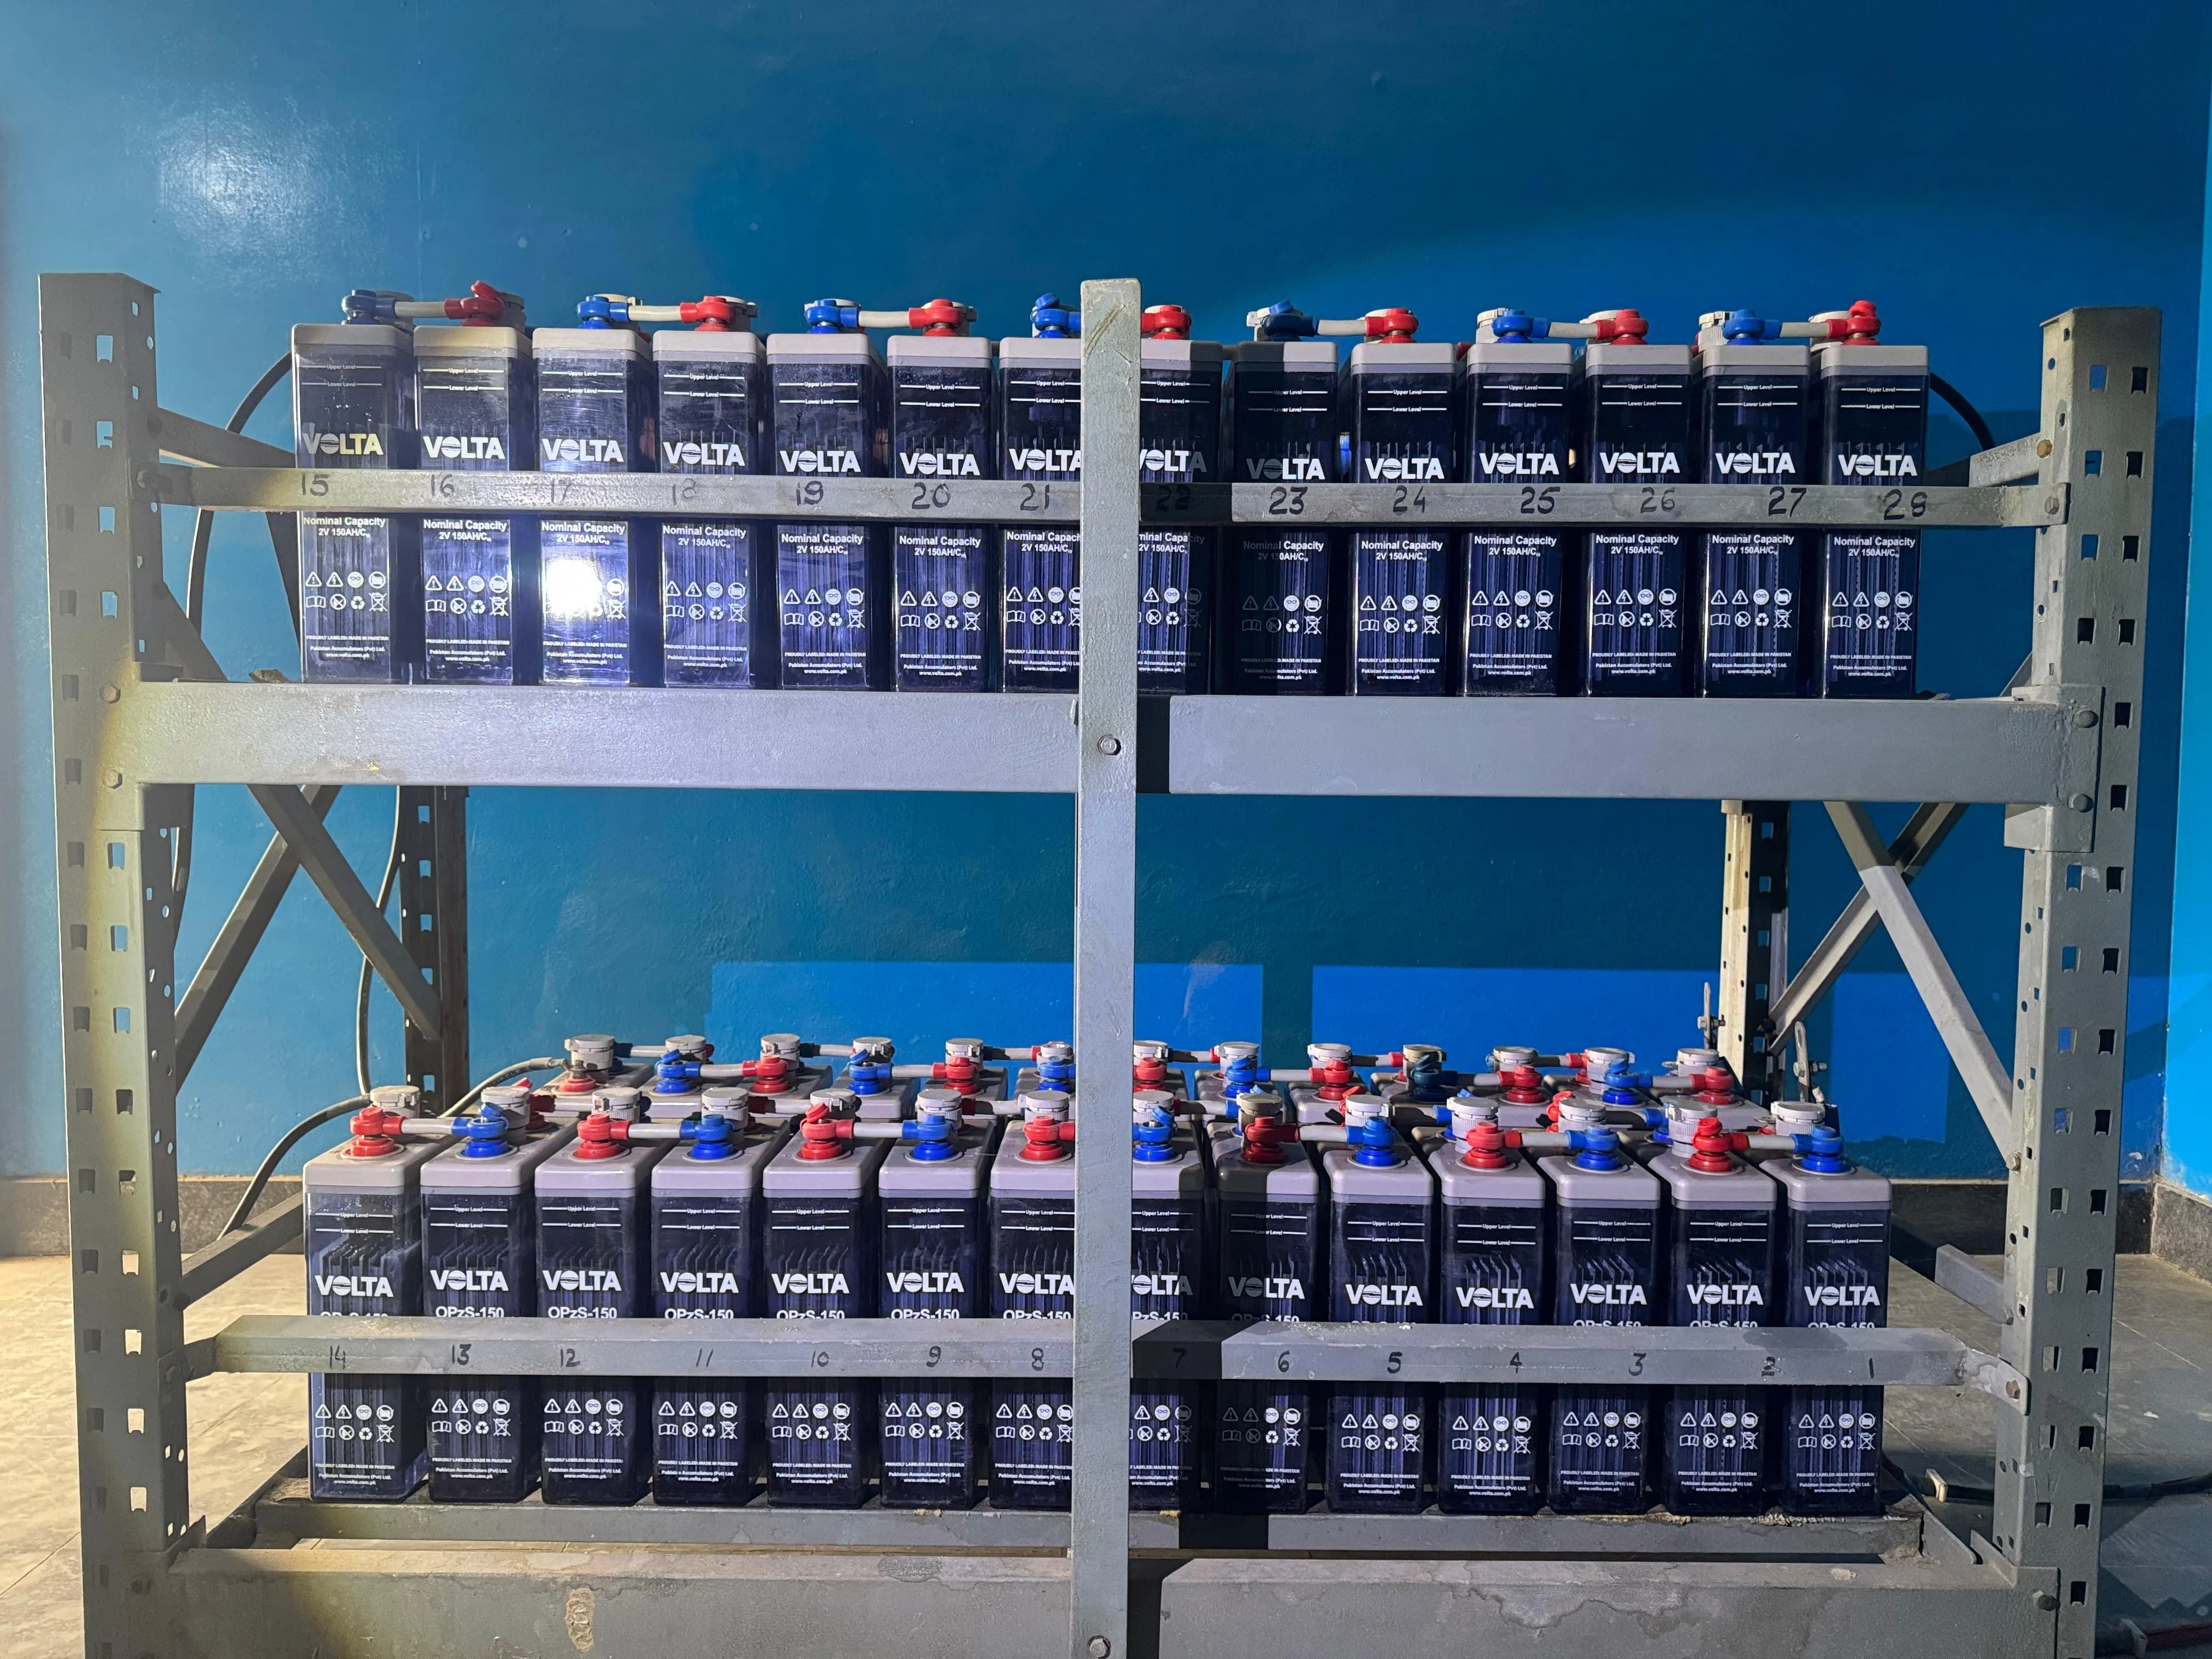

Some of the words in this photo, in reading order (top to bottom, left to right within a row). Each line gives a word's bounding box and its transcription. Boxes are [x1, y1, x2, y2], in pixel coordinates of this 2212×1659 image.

[302, 432, 383, 455] VOLTA
[424, 436, 505, 459] VOLTA
[542, 439, 624, 462] VOLTA
[663, 442, 745, 466] VOLTA
[780, 450, 861, 472] VOLTA
[900, 453, 980, 475] VOLTA
[1246, 458, 1325, 479] VOLTA
[1365, 458, 1444, 479] VOLTA
[1479, 453, 1559, 475] VOLTA
[1600, 452, 1680, 473] VOLTA
[1716, 452, 1795, 473] VOLTA
[1838, 454, 1917, 476] VOLTA
[301, 475, 329, 496] 15
[430, 475, 455, 495] 16
[550, 477, 570, 503] 17
[796, 481, 823, 506] 19
[912, 483, 951, 510] 20
[1020, 484, 1050, 511] 21
[1269, 487, 1308, 515] 23
[1393, 486, 1426, 514] 24
[1521, 487, 1561, 514] 25
[1640, 487, 1675, 512] 26
[1768, 487, 1807, 518] 27
[1884, 489, 1927, 520] 28
[303, 517, 342, 525] Nominal
[345, 517, 386, 528] Capacity
[424, 520, 462, 528] Nominal
[466, 520, 507, 532] Capacity
[541, 522, 580, 532] Nominal
[584, 523, 625, 534] Capacity
[663, 526, 702, 535] Nominal
[705, 527, 746, 538] Capacity
[782, 534, 820, 543] Nominal
[823, 534, 864, 545] Capacity
[900, 536, 938, 545] Nominal
[940, 537, 981, 548] Capacity
[1007, 532, 1045, 541] Nominal
[1139, 532, 1162, 541] minal
[1165, 533, 1205, 544] Capacity
[1243, 541, 1281, 549] Nominal
[1284, 541, 1324, 551] Capacity
[1362, 541, 1400, 549] Nominal
[1402, 541, 1443, 551] Capacity
[1475, 536, 1513, 545] Nominal
[1516, 536, 1556, 546] Capacity
[1596, 535, 1635, 543] Nominal
[1638, 535, 1679, 545] Capacity
[1712, 535, 1751, 544] Nominal
[1753, 535, 1794, 545] Capacity
[1834, 537, 1872, 545] Nominal
[1875, 537, 1915, 548] Capacity
[315, 1276, 393, 1297] VOLTA
[430, 1269, 509, 1291] VOLTA
[542, 1270, 622, 1291] VOLTA
[661, 1272, 738, 1293] VOLTA
[771, 1273, 849, 1294] VOLTA
[886, 1272, 964, 1293] VOLTA
[1000, 1273, 1074, 1295] VOLTA
[1131, 1274, 1193, 1295] OLTA
[1228, 1276, 1305, 1299] VOLTA
[1346, 1284, 1423, 1306] VOLTA
[1455, 1286, 1534, 1309] VOLTA
[1570, 1284, 1647, 1305] VOLTA
[1686, 1284, 1764, 1305] VOLTA
[1804, 1286, 1880, 1306] VOLTA
[436, 1306, 504, 1317] OPzS-150
[548, 1306, 617, 1318] OPzS-150
[329, 1345, 346, 1369] 14
[452, 1344, 472, 1365] 13
[561, 1348, 580, 1367] 12
[695, 1349, 714, 1367] 11
[811, 1351, 829, 1368] 10
[926, 1346, 941, 1367] 9
[1031, 1348, 1044, 1371] 8
[1172, 1348, 1186, 1369] 7
[1277, 1350, 1289, 1373] 6
[1387, 1352, 1403, 1373] 5
[1510, 1352, 1522, 1374] 4
[1629, 1352, 1646, 1376] 3
[1762, 1357, 1776, 1376] 2
[1869, 1358, 1874, 1379] 1
